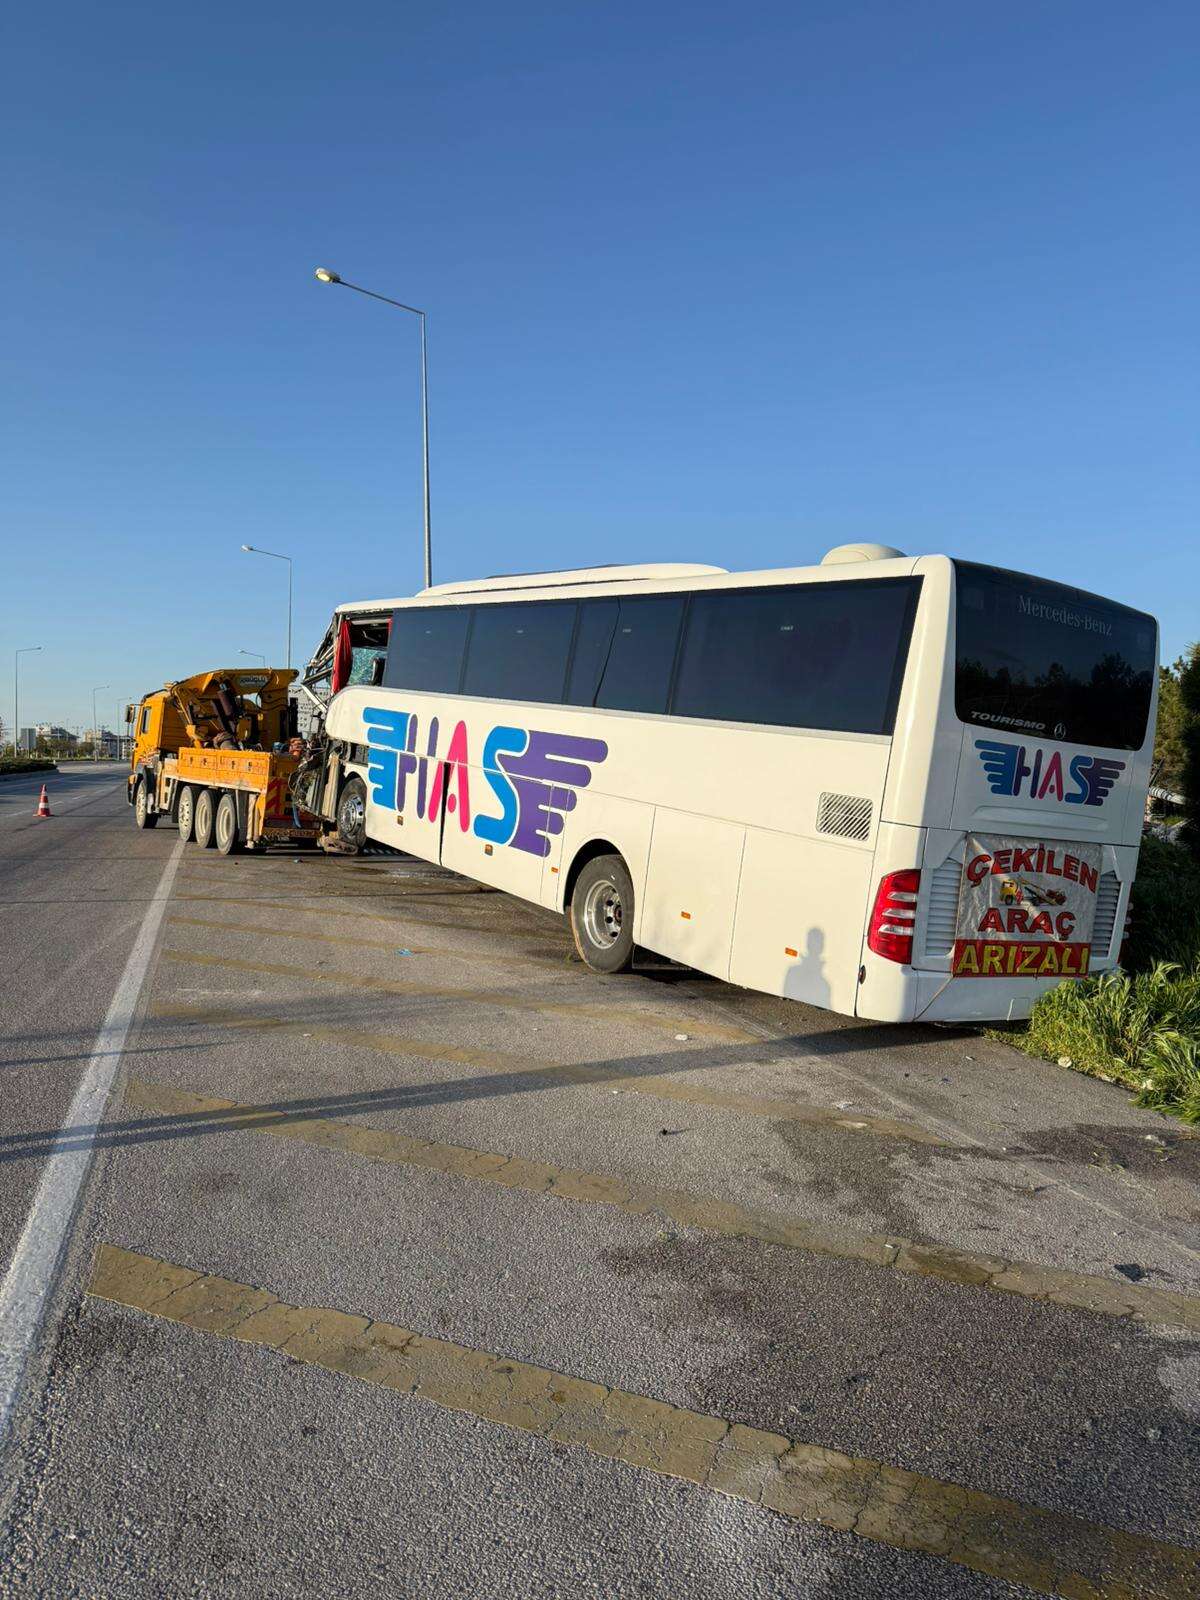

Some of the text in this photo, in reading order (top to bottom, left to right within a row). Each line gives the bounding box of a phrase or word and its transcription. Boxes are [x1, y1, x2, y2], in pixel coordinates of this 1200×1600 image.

[1018, 595, 1113, 637] Mercedes-Benz
[971, 710, 1047, 731] TOURISMO
[967, 843, 1098, 893] ÇEKİLEN
[977, 907, 1077, 941] ARAÇ
[957, 944, 1089, 975] ARIZALI
